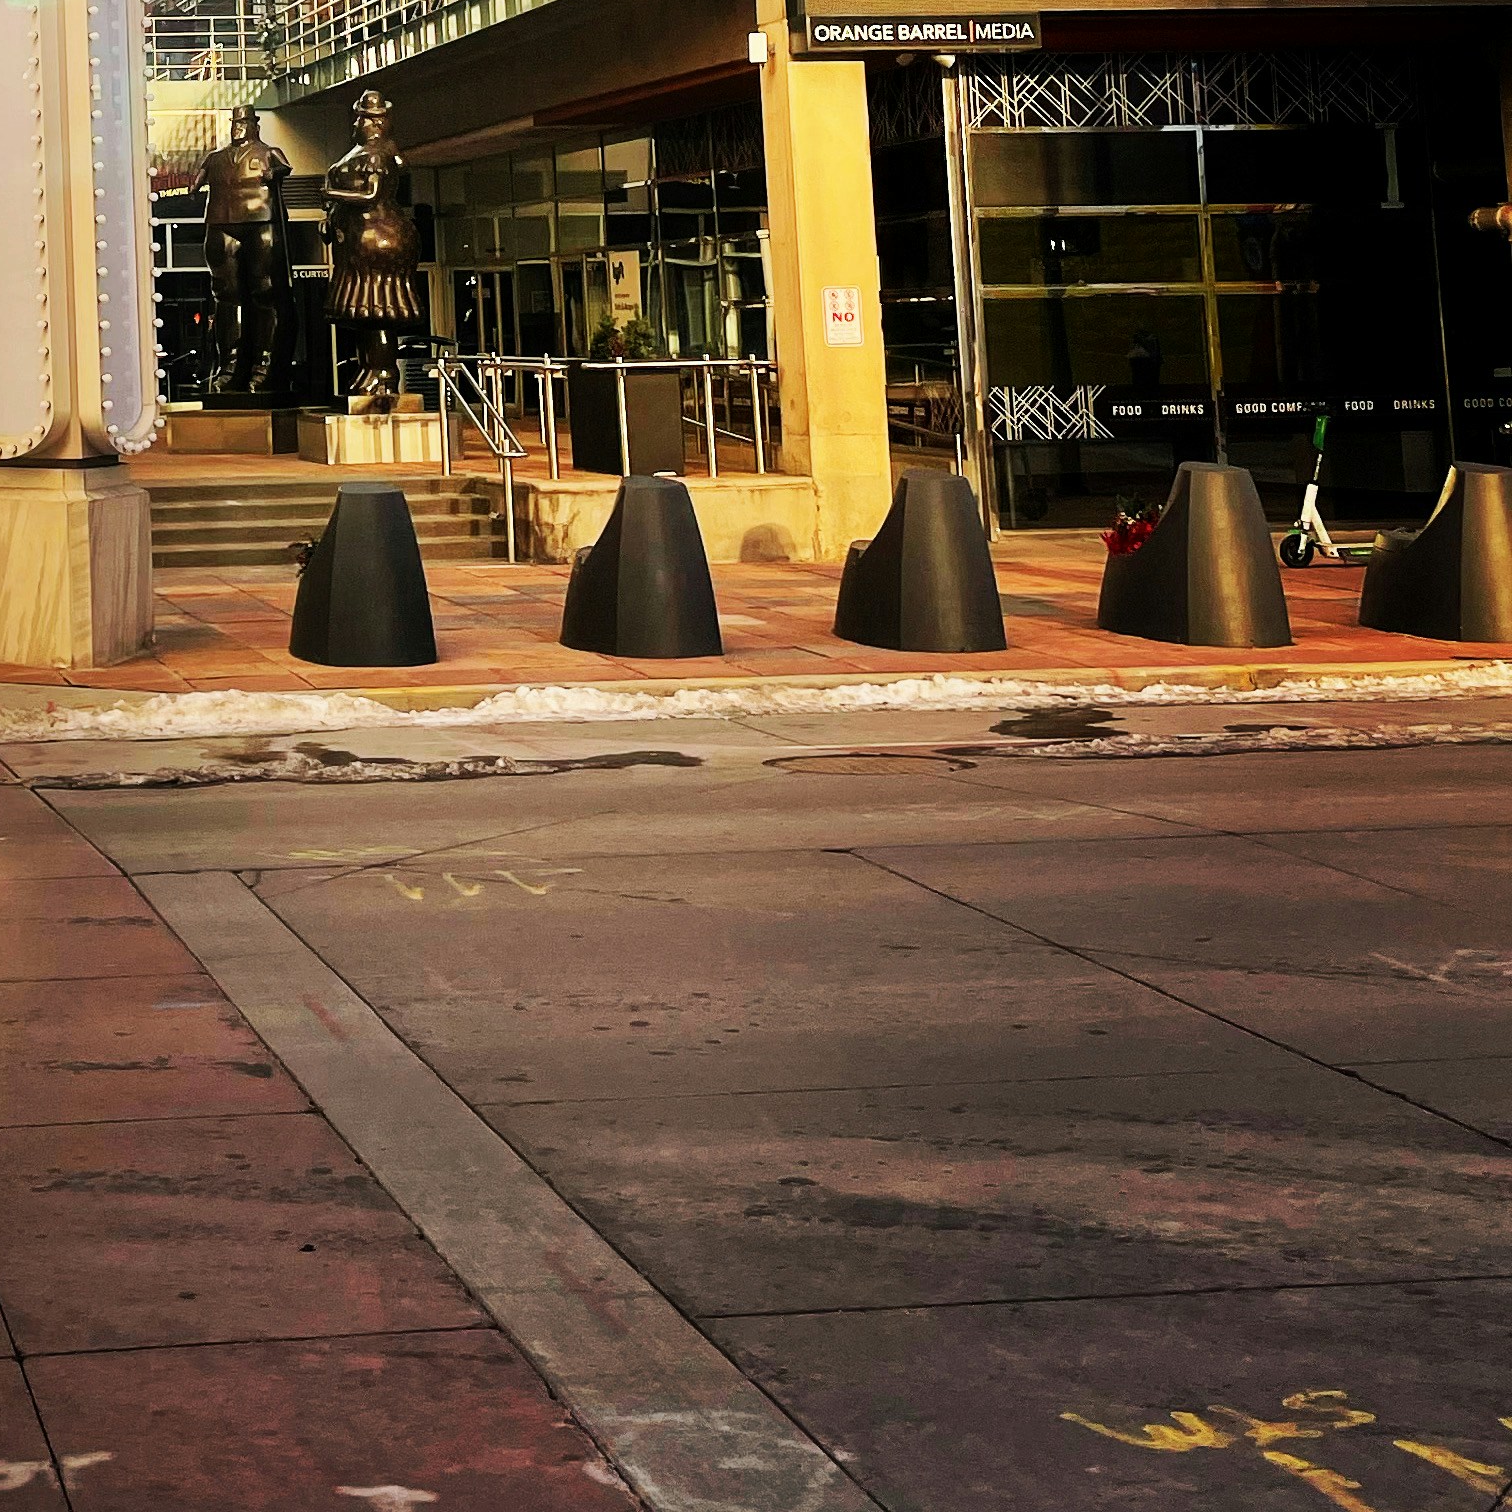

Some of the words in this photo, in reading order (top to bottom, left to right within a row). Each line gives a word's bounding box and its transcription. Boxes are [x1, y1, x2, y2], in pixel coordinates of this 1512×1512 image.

[814, 24, 894, 41] ORANGE
[897, 23, 968, 41] BARREL
[976, 22, 1035, 40] MEDIA
[832, 312, 855, 323] NO
[1112, 405, 1142, 416] FOOD
[1161, 404, 1204, 415] DRINKS
[1235, 402, 1267, 414] GOOD
[1345, 400, 1374, 411] FOOD
[1393, 399, 1436, 410] DRINKS
[1464, 398, 1494, 409] GOOD
